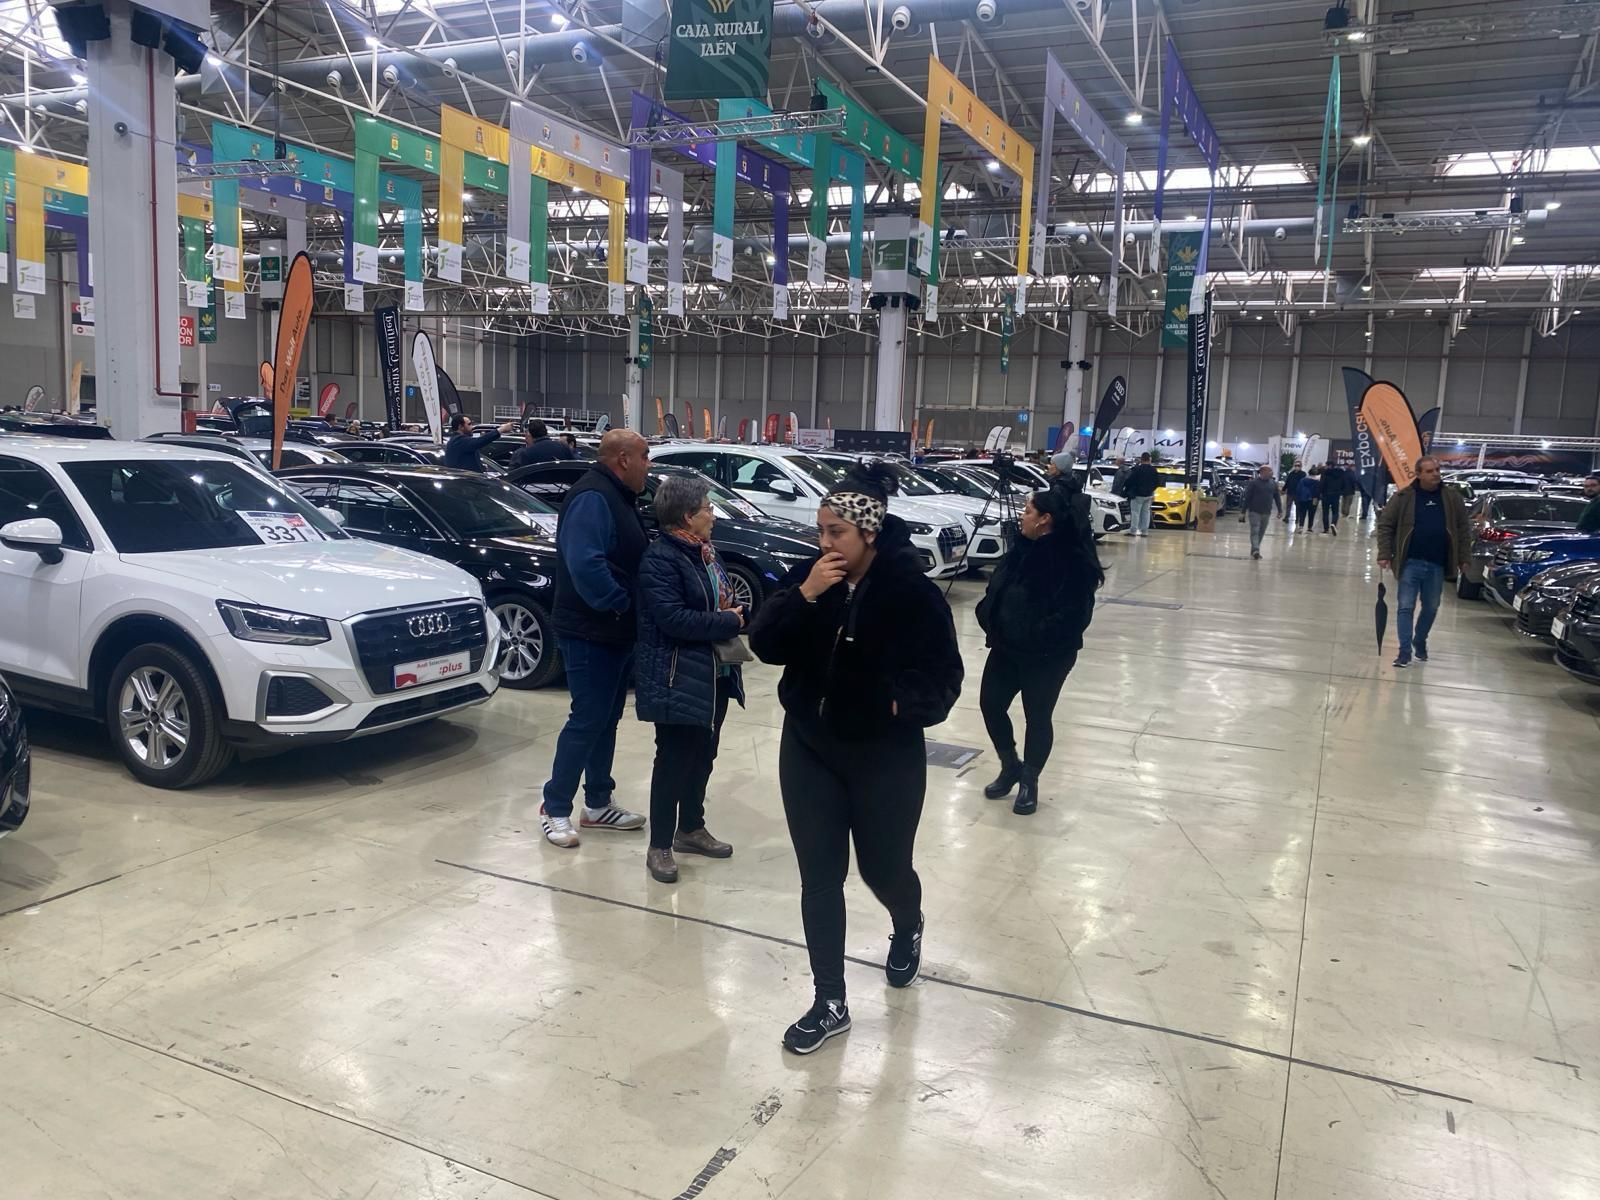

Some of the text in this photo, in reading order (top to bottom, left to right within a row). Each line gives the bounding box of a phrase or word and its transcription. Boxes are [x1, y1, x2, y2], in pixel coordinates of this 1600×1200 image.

[676, 21, 763, 38] CAJA RURAL
[700, 40, 736, 57] JAÉN
[1018, 413, 1029, 421] 10
[1335, 449, 1354, 458] The
[260, 525, 309, 542] 331
